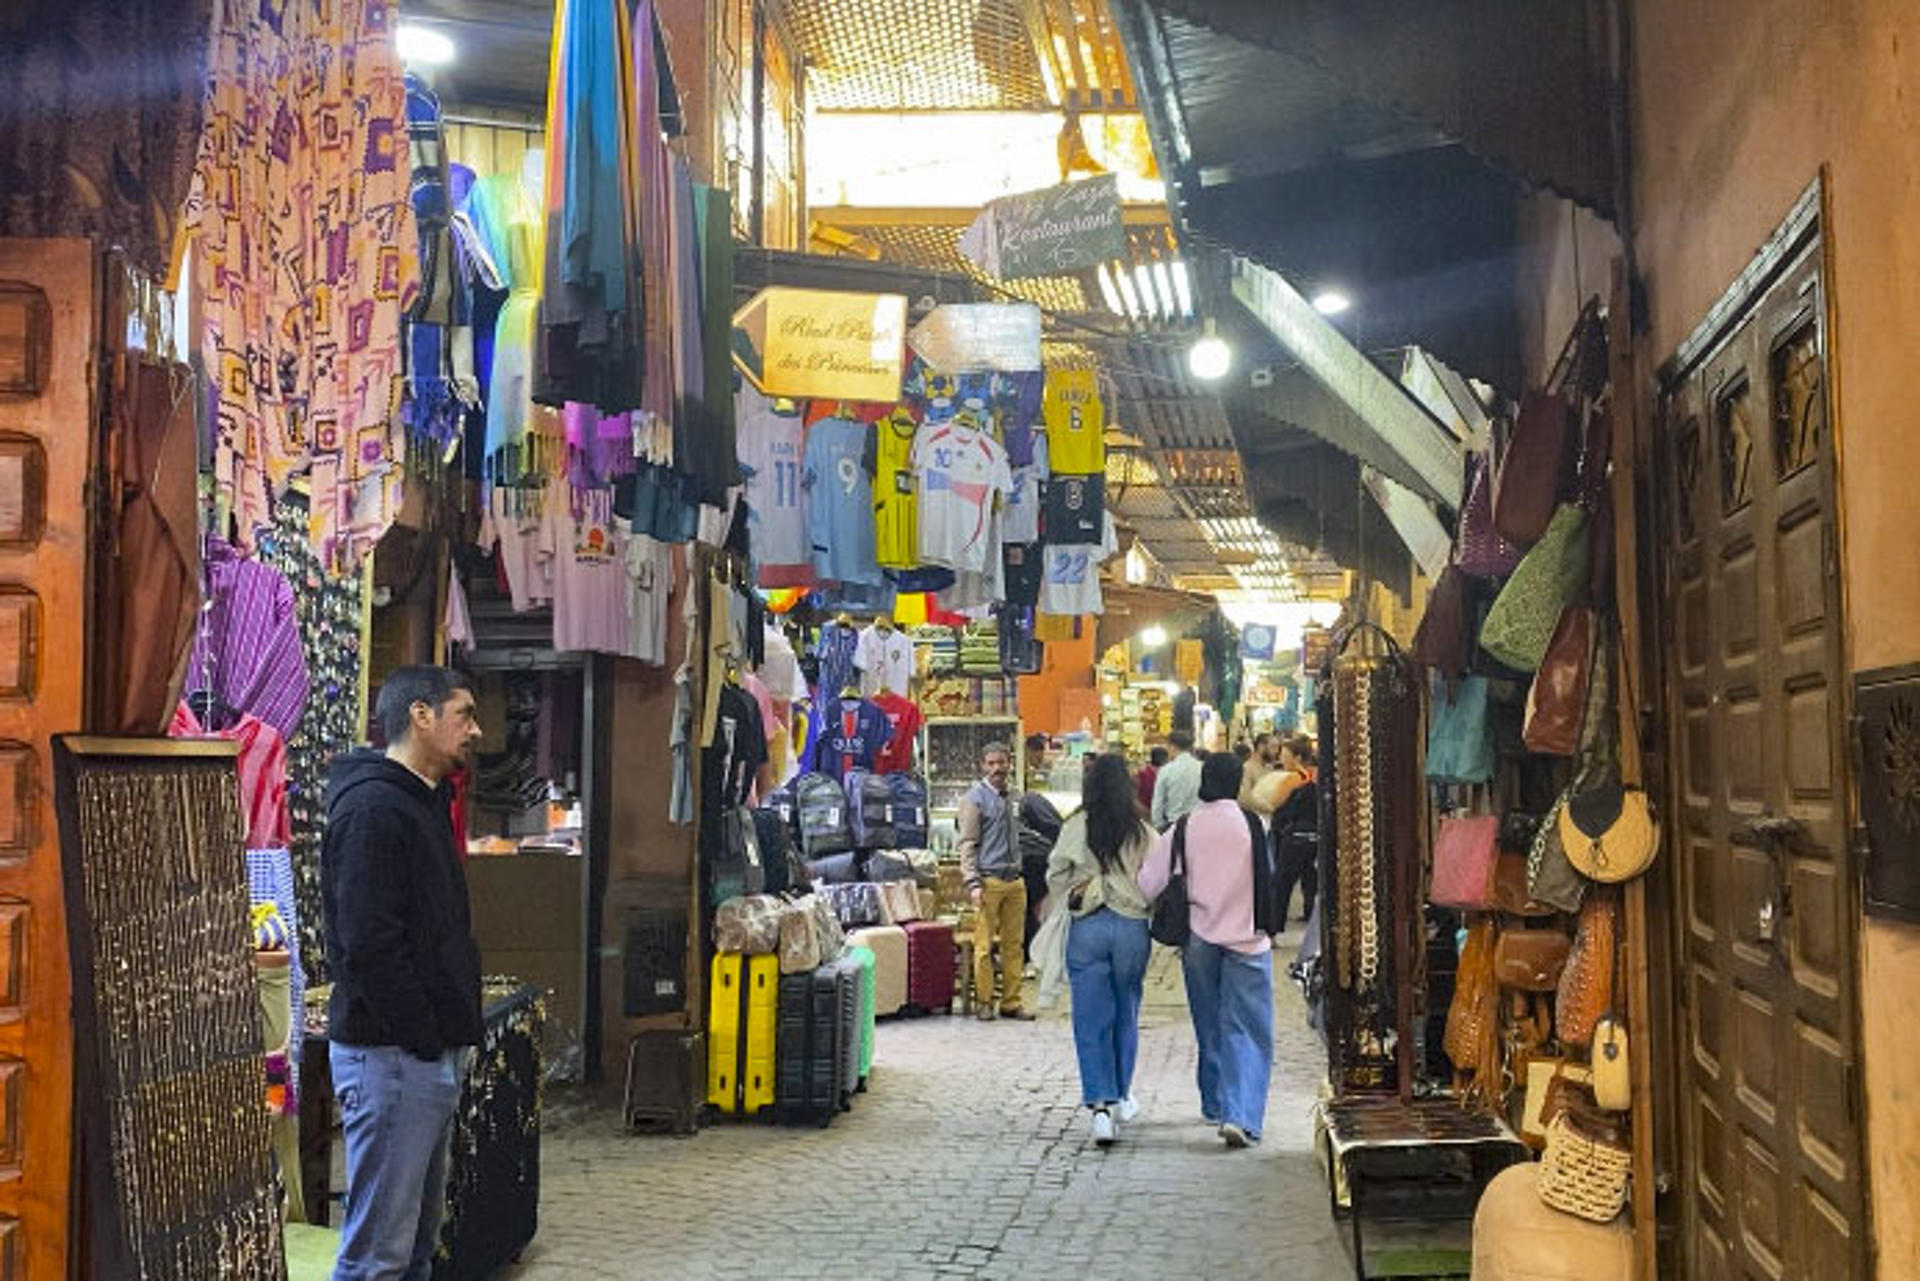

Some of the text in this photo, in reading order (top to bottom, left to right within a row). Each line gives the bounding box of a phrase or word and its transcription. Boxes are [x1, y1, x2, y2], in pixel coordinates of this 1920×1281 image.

[1001, 204, 1118, 251] Restaurant
[1070, 405, 1083, 431] 6
[774, 460, 796, 508] 11
[838, 457, 859, 496] 9
[1052, 552, 1088, 584] 22
